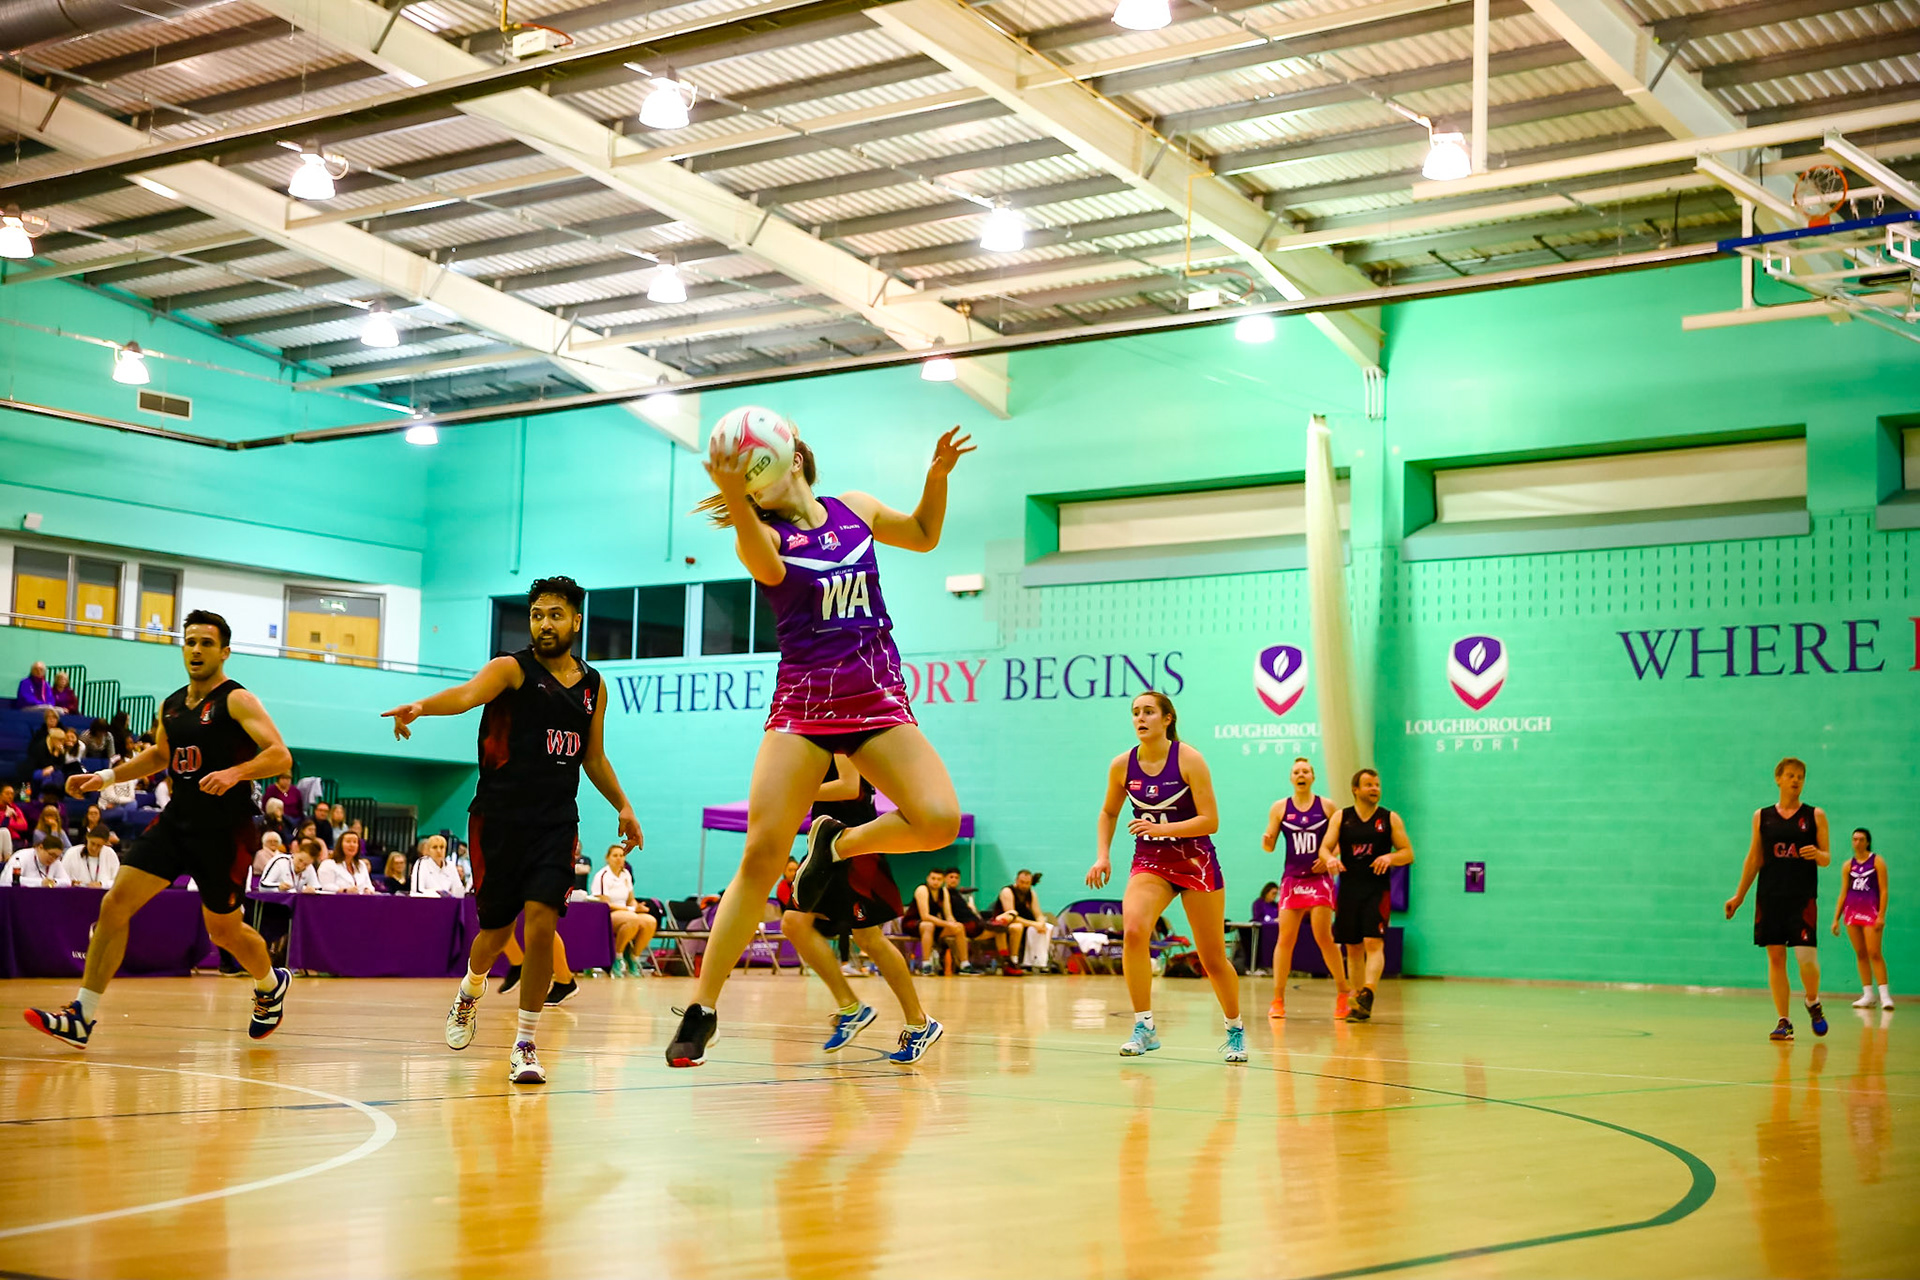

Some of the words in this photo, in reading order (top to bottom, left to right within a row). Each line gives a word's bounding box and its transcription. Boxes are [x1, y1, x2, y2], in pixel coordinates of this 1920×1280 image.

[817, 571, 873, 620] WA
[1616, 619, 1885, 680] WHERE
[615, 670, 764, 714] WHERE
[1002, 651, 1184, 700] BEGINS
[1214, 722, 1322, 738] LOUGHBOROU
[1405, 717, 1552, 735] LOUGHBOROUGH
[547, 729, 580, 756] WD
[1242, 742, 1318, 755] SPORT
[1436, 738, 1519, 752] SPORT
[172, 745, 202, 774] GD
[1292, 831, 1317, 855] WD
[1773, 842, 1799, 858] GA
